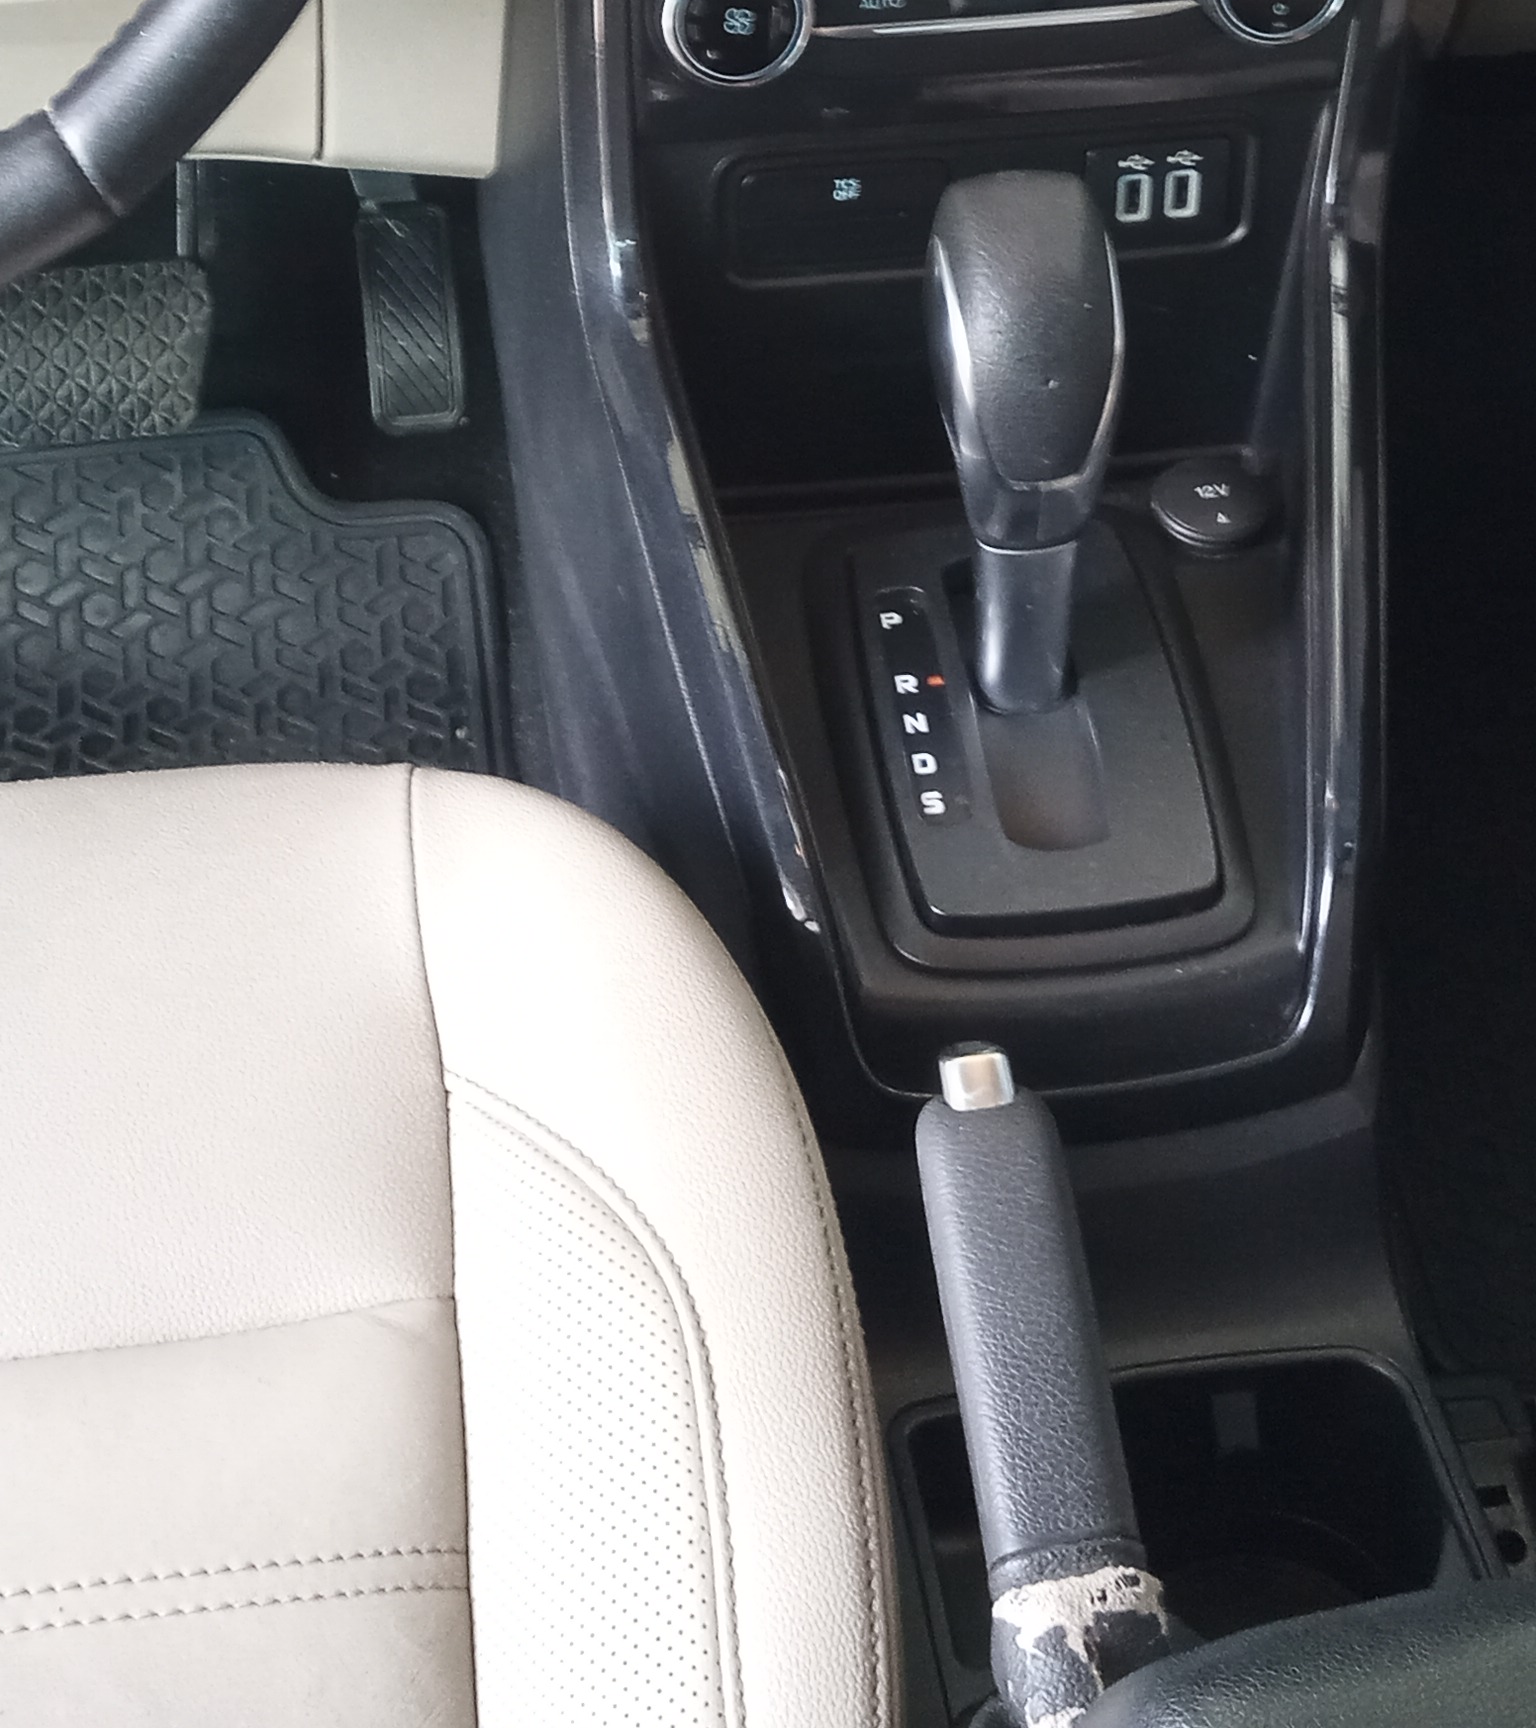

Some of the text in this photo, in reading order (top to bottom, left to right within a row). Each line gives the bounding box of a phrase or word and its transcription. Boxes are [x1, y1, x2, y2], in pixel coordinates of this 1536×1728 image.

[1194, 481, 1231, 501] 12V
[879, 610, 904, 631] P
[894, 673, 920, 695] R
[902, 711, 930, 735] N
[911, 751, 939, 775] D
[919, 791, 947, 816] S
